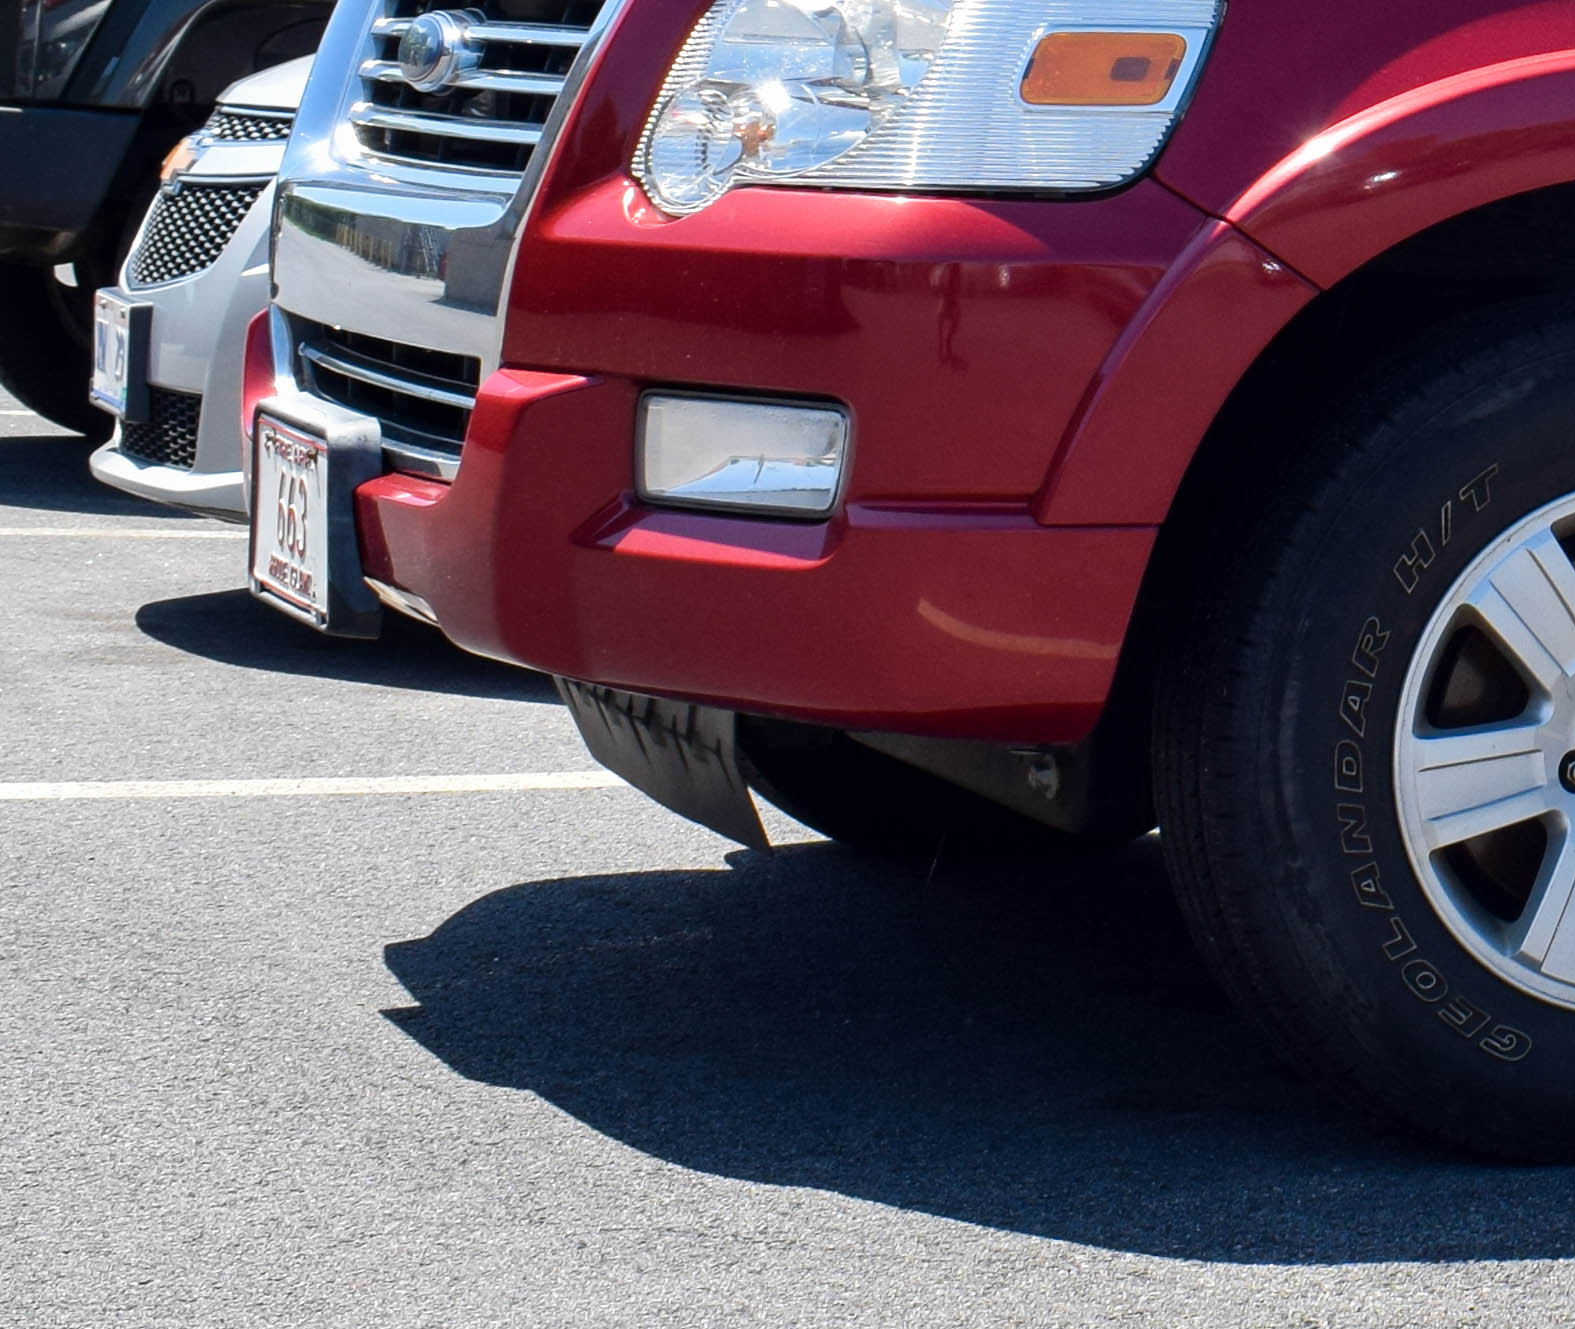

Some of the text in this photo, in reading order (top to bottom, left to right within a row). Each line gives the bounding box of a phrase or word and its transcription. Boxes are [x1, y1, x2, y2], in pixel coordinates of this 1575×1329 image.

[278, 469, 308, 560] 663
[1333, 464, 1534, 1063] GEOLANDAR H/T
